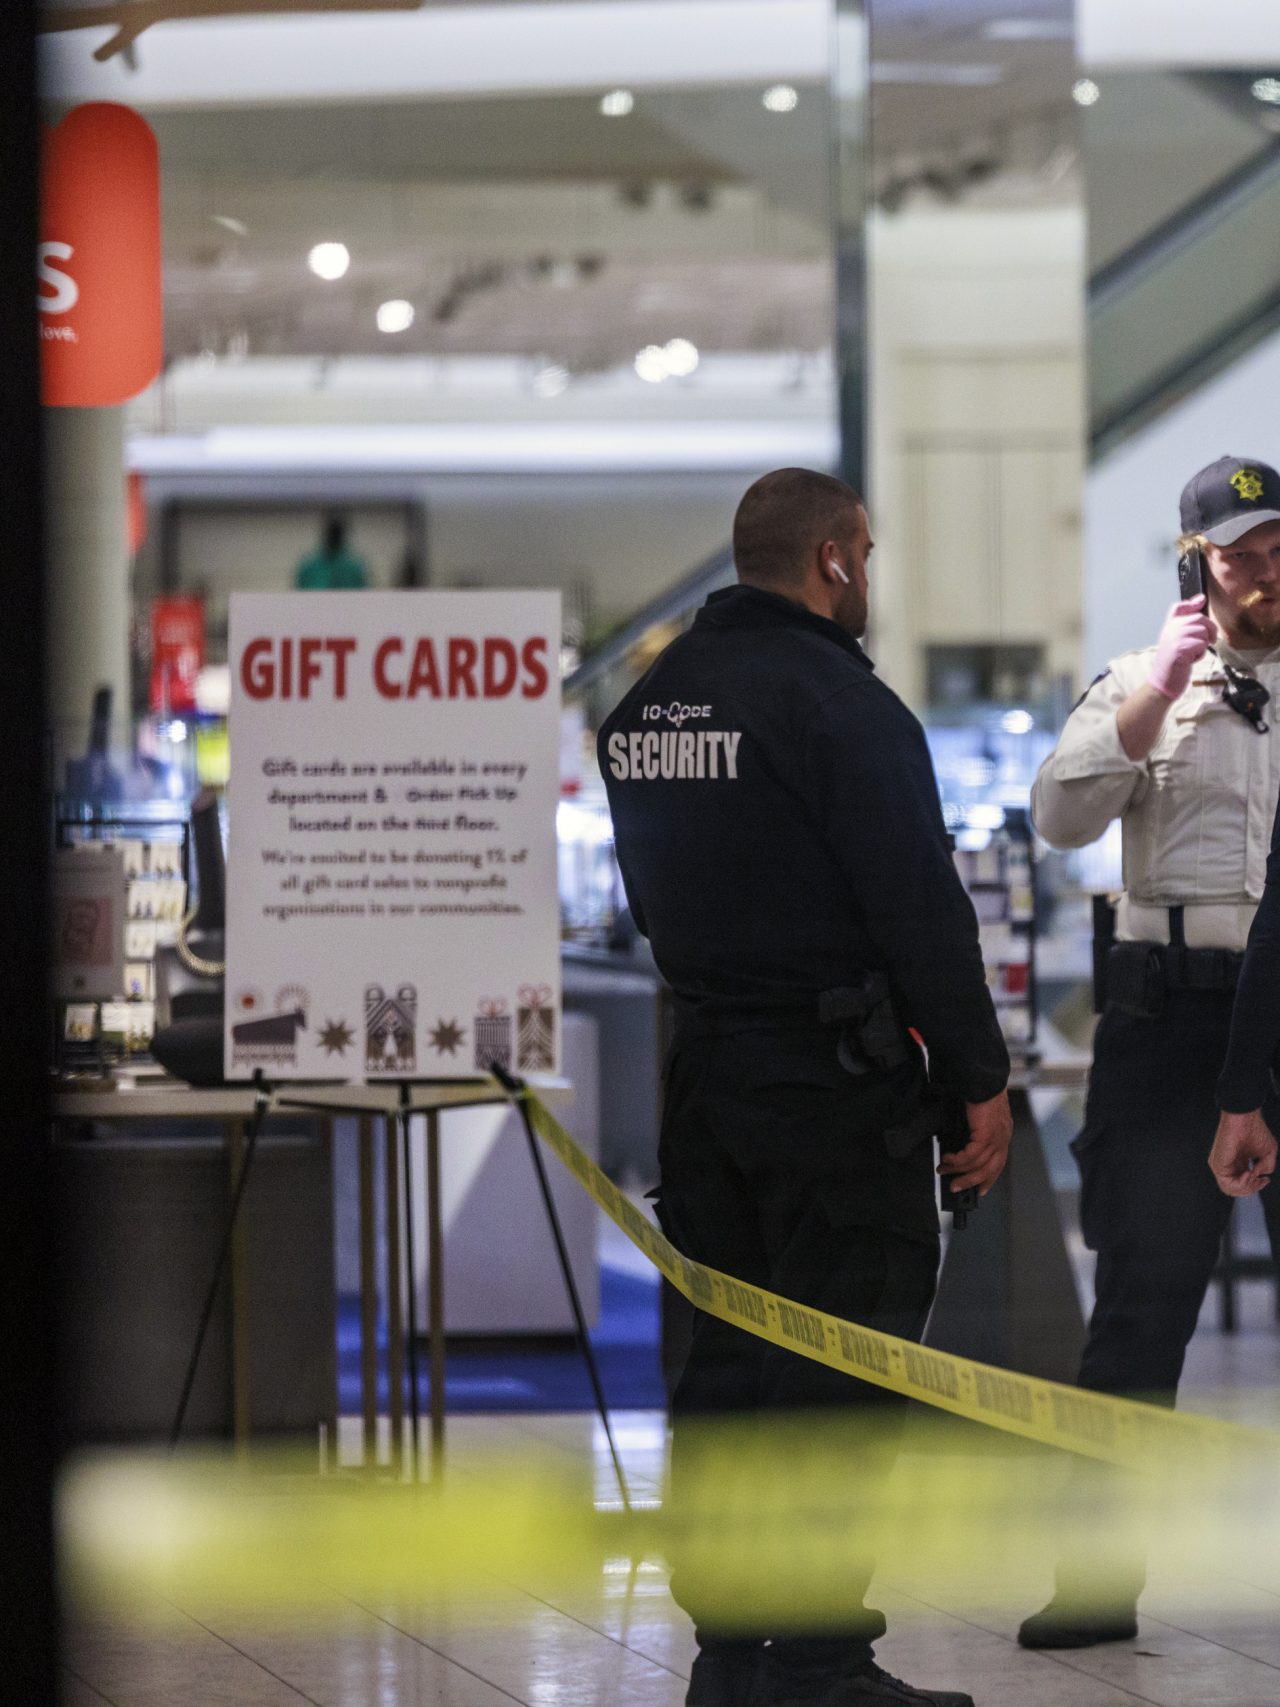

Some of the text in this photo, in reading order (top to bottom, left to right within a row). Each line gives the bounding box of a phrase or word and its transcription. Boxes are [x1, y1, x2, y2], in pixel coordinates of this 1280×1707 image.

[240, 637, 549, 701] GIFT CARDS
[608, 731, 742, 781] SECURITY
[262, 757, 527, 782] Gift cards are available in every
[267, 787, 367, 809] department
[374, 785, 387, 803] &
[289, 815, 352, 831] located
[356, 820, 377, 831] on
[381, 814, 409, 831] the
[454, 813, 499, 831] floor.
[414, 849, 482, 869] donating
[302, 874, 331, 895] gift
